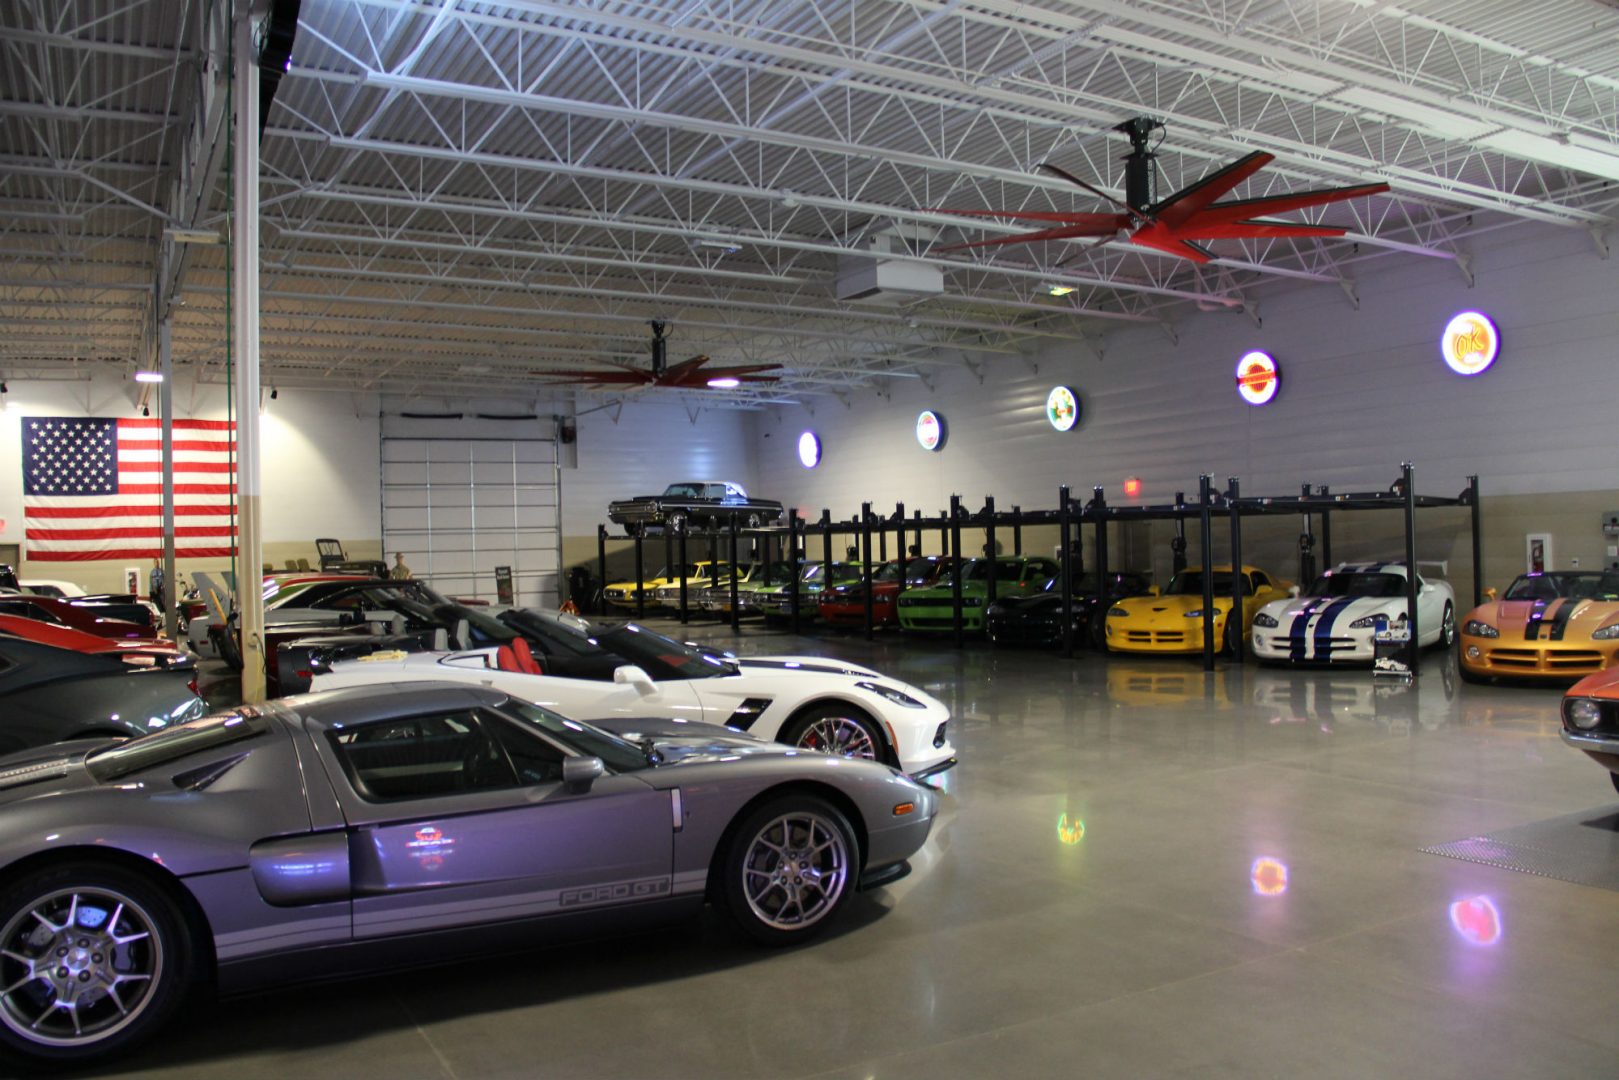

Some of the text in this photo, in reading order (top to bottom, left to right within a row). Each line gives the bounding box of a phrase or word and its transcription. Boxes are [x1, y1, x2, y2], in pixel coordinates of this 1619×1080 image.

[1455, 326, 1484, 360] OK
[562, 878, 668, 905] FORD GT
